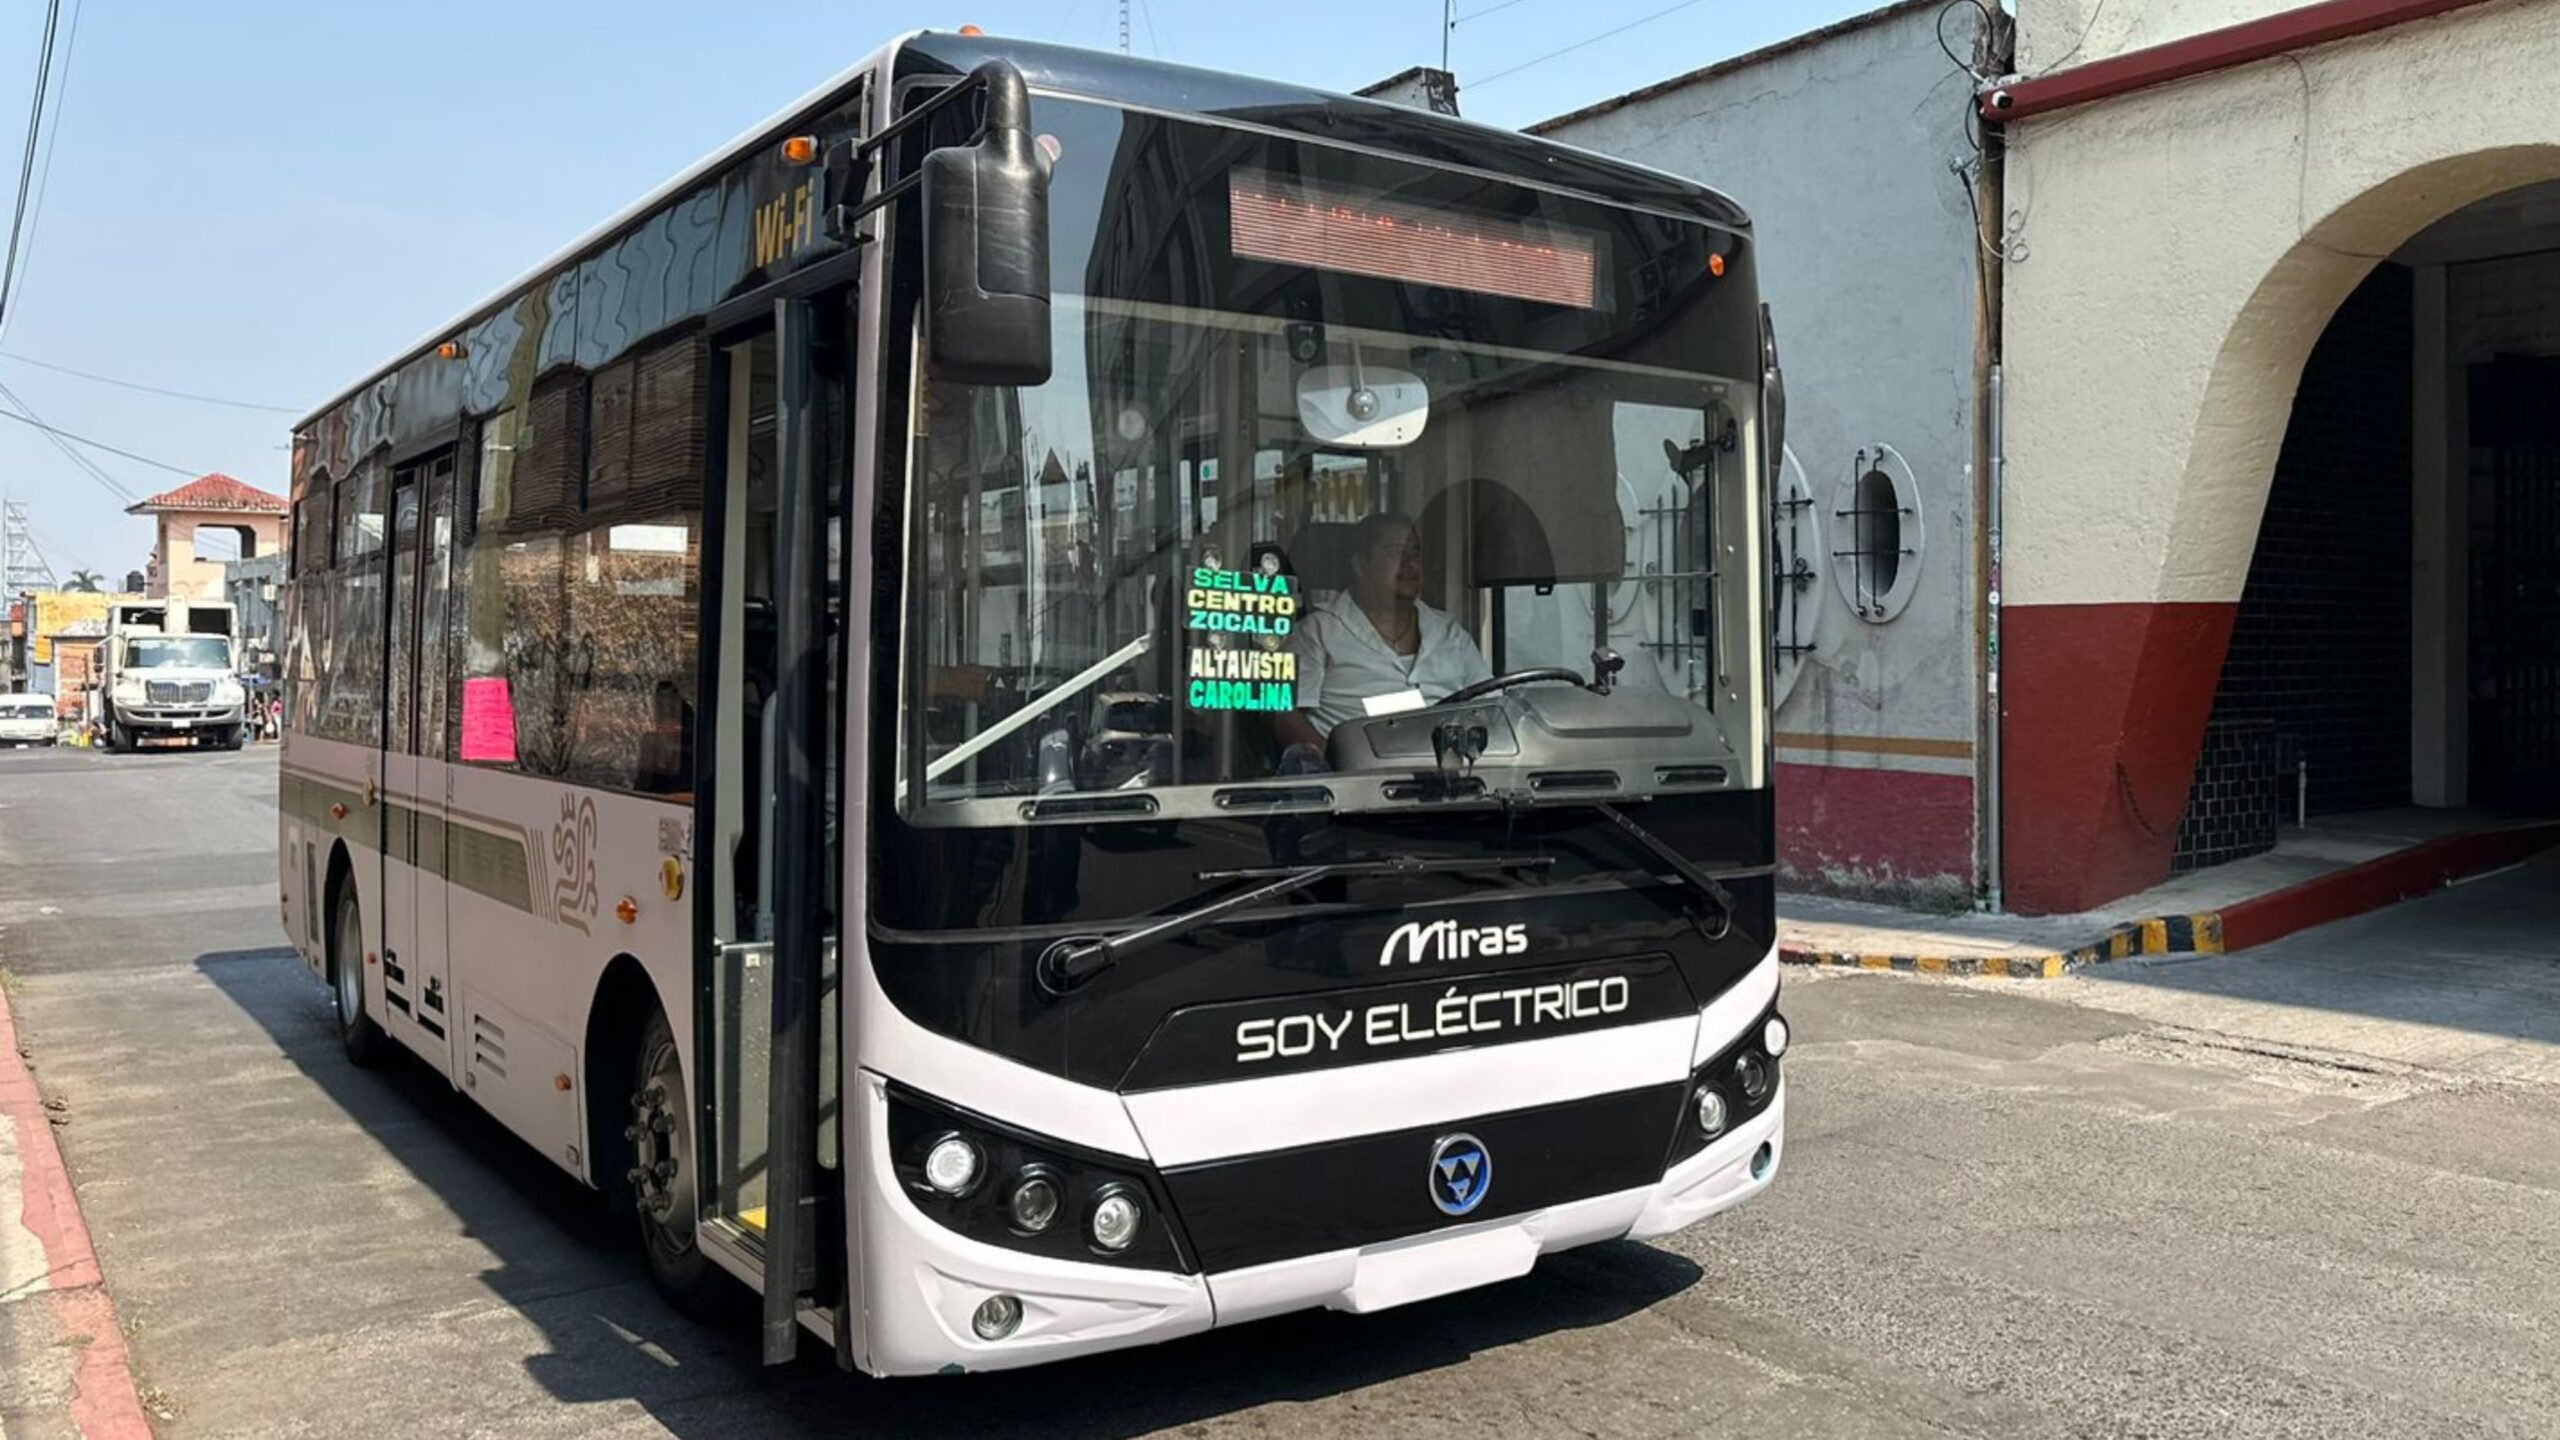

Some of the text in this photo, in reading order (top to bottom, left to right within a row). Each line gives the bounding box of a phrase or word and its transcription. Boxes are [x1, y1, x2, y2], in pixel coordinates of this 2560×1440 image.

[1194, 569, 1288, 593] SELVA
[1187, 589, 1295, 615] CENTRO
[1189, 611, 1290, 635] ZOCALO
[1379, 920, 1527, 966] Miras
[1236, 976, 1629, 1063] SOY ELÉCTRICO
